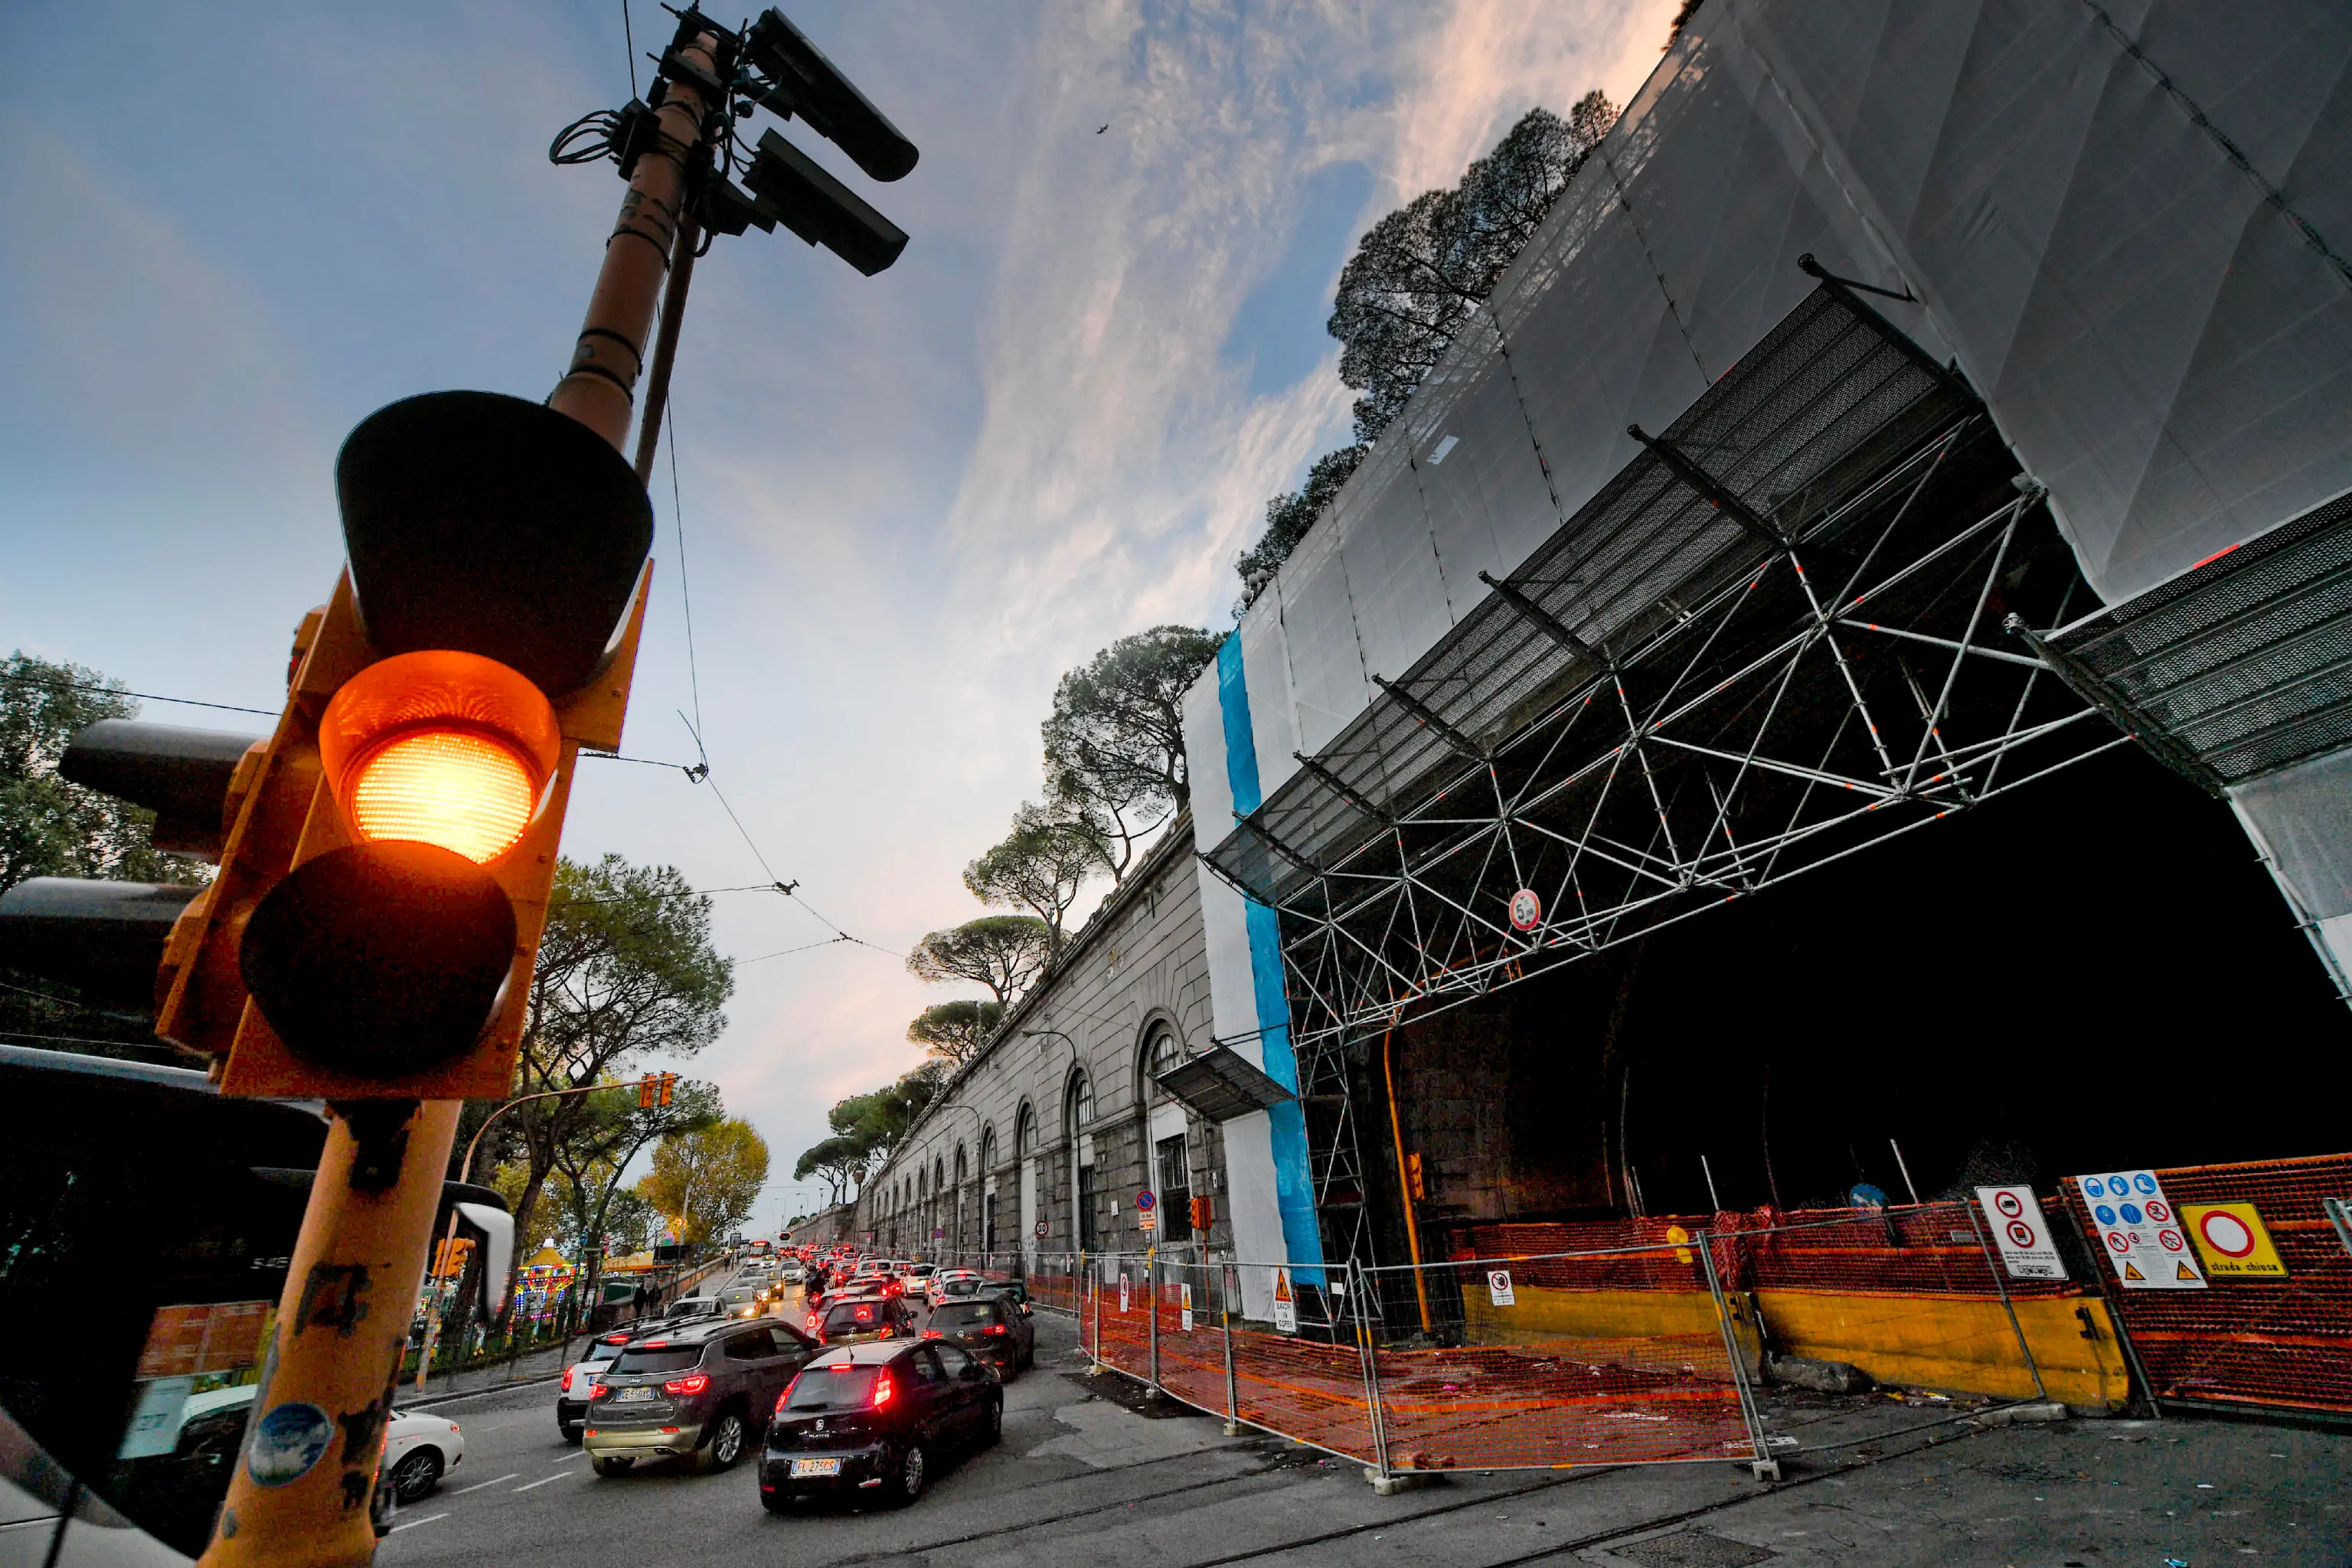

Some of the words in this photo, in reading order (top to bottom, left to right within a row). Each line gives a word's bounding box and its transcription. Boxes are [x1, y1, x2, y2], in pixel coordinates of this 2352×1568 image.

[1038, 1224, 1046, 1233] 30
[2211, 1262, 2241, 1271] strada
[2245, 1262, 2278, 1272] chiusa
[798, 1462, 805, 1472] FL
